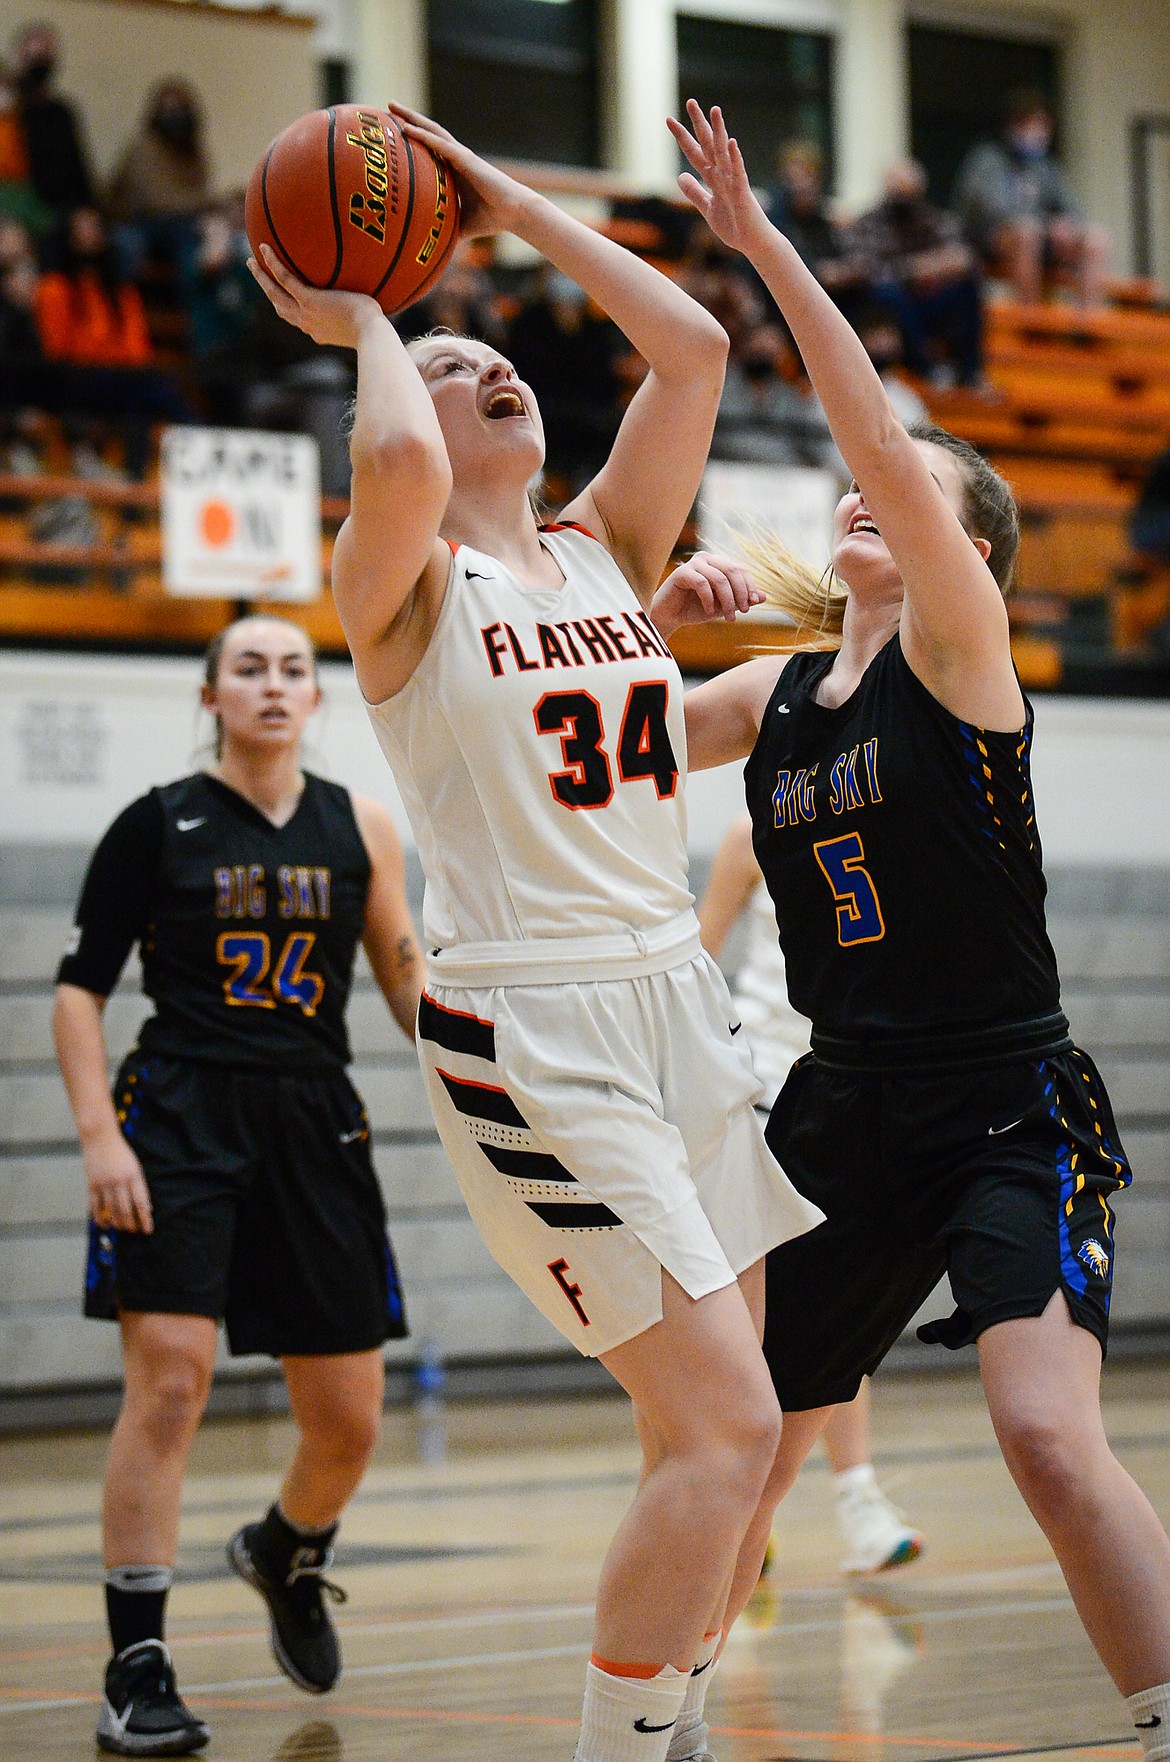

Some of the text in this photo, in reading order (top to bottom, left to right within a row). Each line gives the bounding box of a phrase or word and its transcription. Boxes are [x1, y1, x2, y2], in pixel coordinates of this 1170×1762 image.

[346, 111, 389, 246] Baden
[532, 679, 680, 812] 34
[772, 737, 883, 829] BIG SKY
[213, 863, 332, 921] BIG SKY
[813, 831, 886, 948] 5
[215, 930, 326, 1018] 24
[546, 1257, 592, 1328] F
